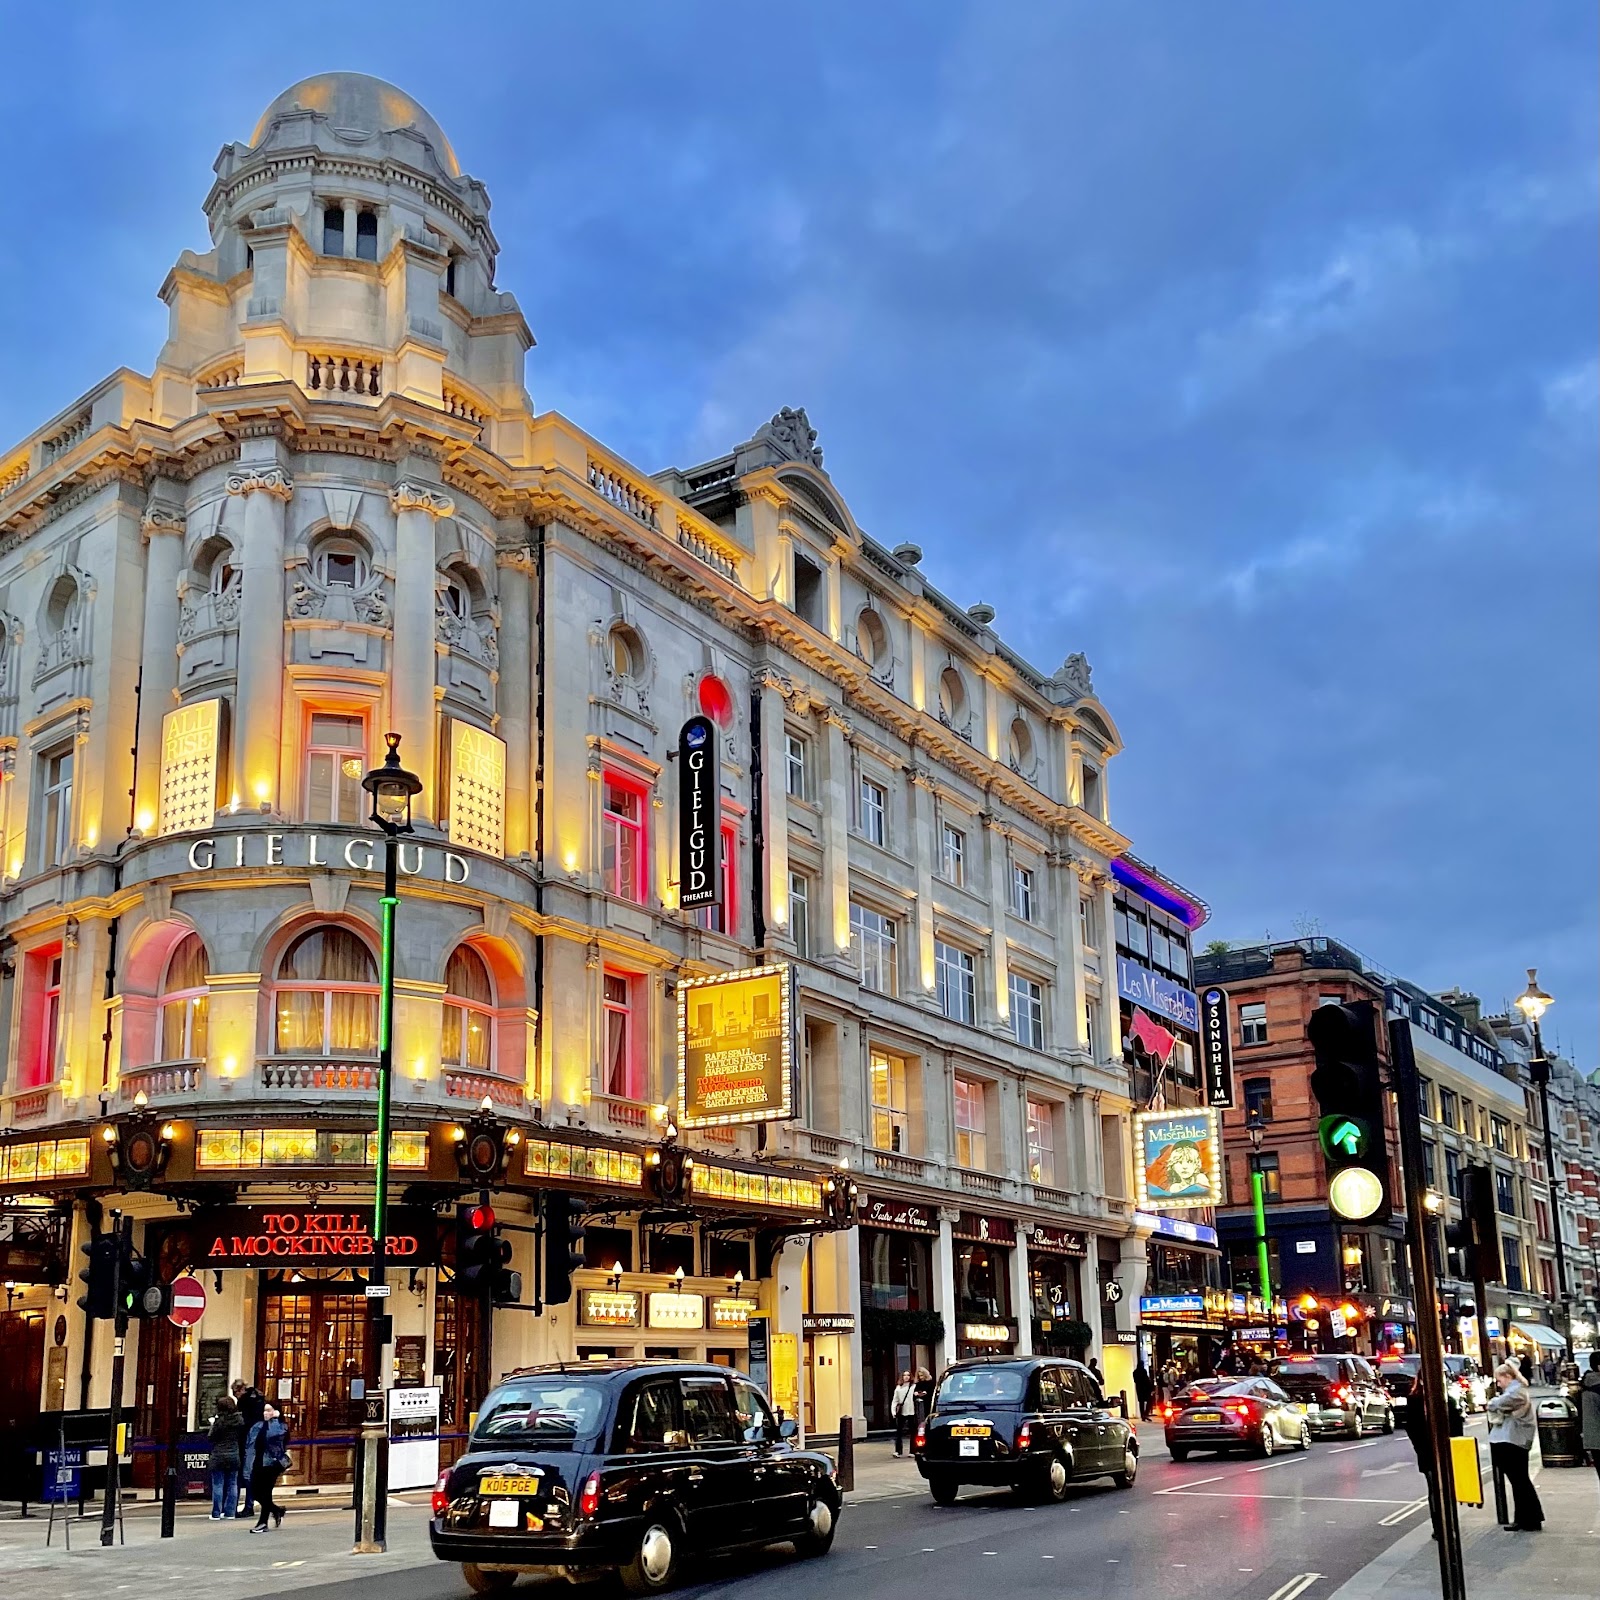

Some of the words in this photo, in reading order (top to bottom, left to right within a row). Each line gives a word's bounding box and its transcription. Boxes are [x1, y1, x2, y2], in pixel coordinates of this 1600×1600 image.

[165, 706, 213, 742] ALL
[165, 729, 213, 763] RISE
[456, 728, 502, 768] ALL
[456, 749, 502, 788] RISE
[688, 750, 706, 891] GIELGUD
[188, 834, 469, 883] GIELGUD
[682, 890, 713, 902] THEATRE
[1121, 962, 1141, 999] Les
[1141, 972, 1195, 1024] Misérables
[704, 1050, 727, 1061] RAFE
[1209, 1006, 1225, 1100] SONDHEIM
[704, 1065, 738, 1077] HARPER
[739, 1062, 764, 1073] LEE'S
[705, 1057, 739, 1069] ATTICUS
[697, 1077, 708, 1086] TO
[709, 1074, 728, 1083] KILL
[704, 1078, 762, 1093] MOCKINGBIRD
[705, 1089, 732, 1100] AARON
[733, 1085, 765, 1096] SORKIN
[705, 1096, 745, 1108] BARTLETT
[745, 1093, 768, 1103] SHER
[1148, 1126, 1207, 1142] Misérables
[1168, 1122, 1183, 1131] Les
[262, 1214, 299, 1234] TO
[303, 1214, 367, 1234] KILL
[208, 1237, 227, 1256] A
[230, 1236, 418, 1256] MOCKINGBRD
[1146, 1300, 1160, 1309] Les
[184, 1453, 210, 1461] HOUSE
[186, 1461, 207, 1469] FULL
[486, 1480, 509, 1492] KD15
[510, 1480, 532, 1492] PGE
